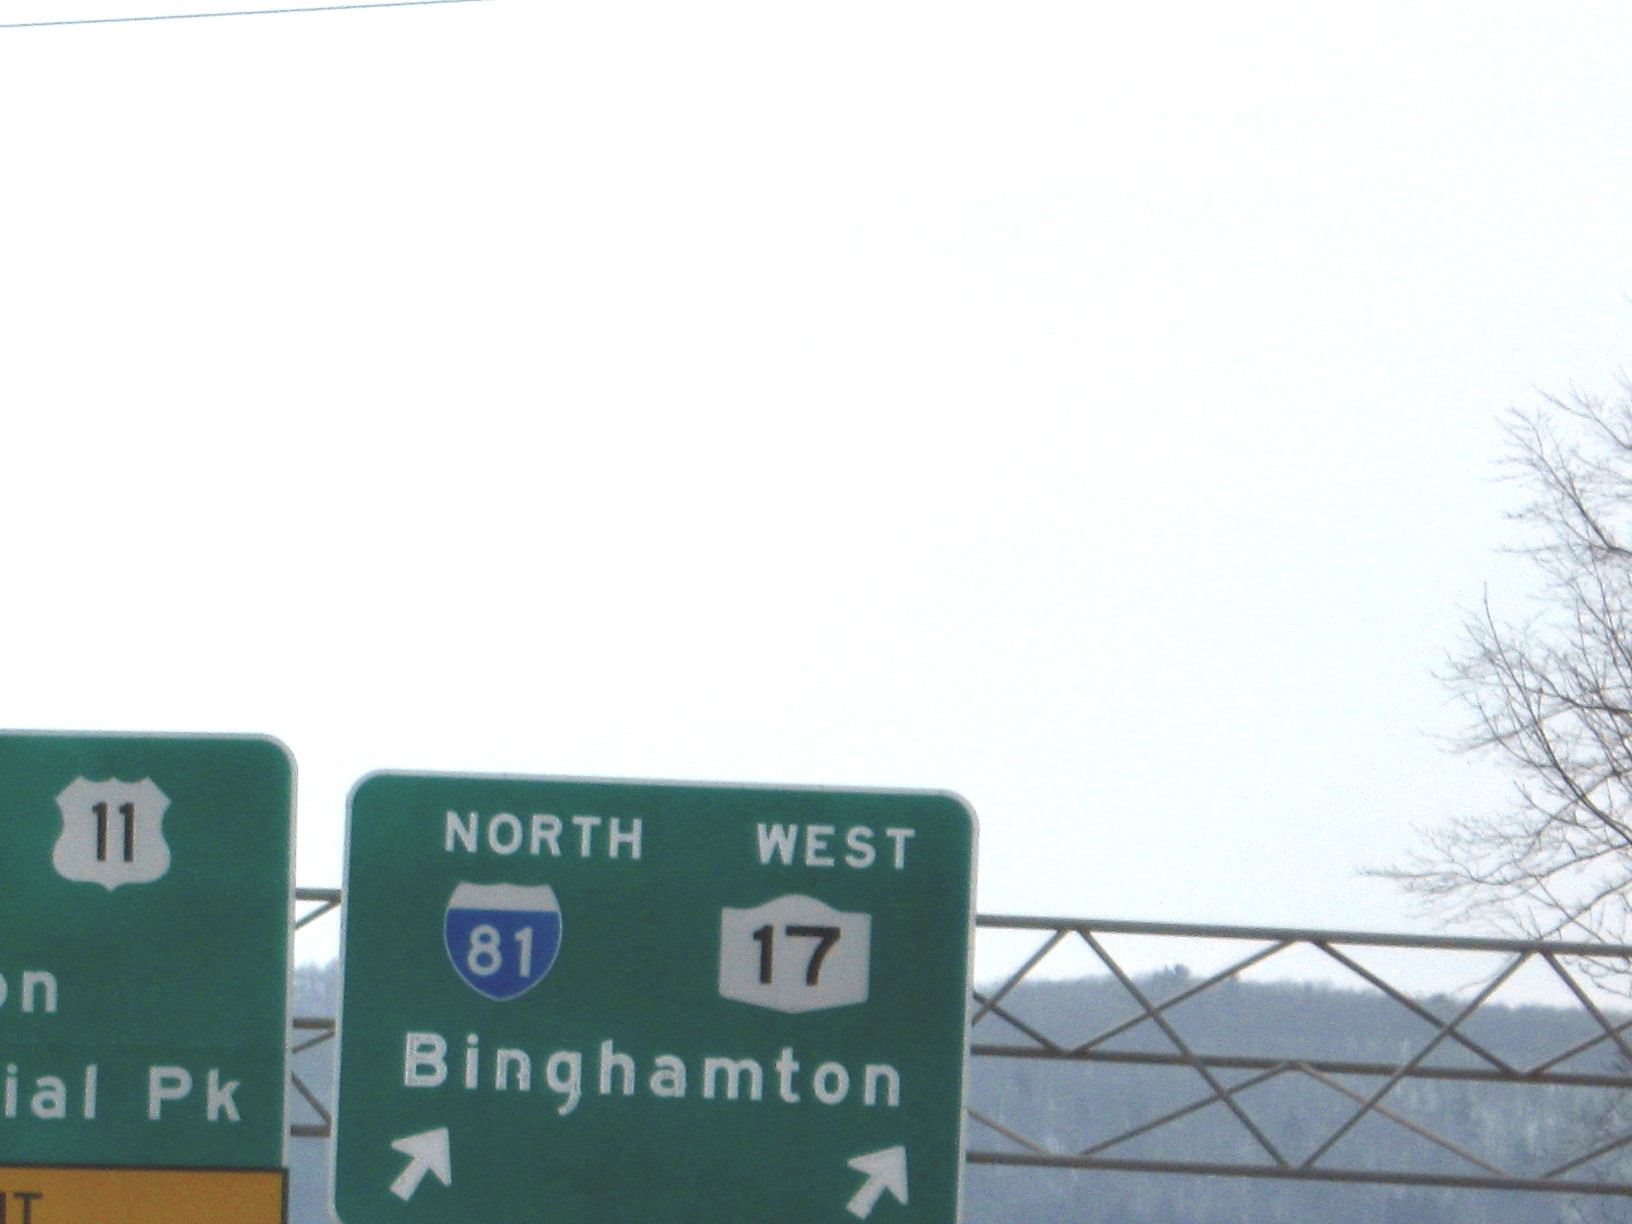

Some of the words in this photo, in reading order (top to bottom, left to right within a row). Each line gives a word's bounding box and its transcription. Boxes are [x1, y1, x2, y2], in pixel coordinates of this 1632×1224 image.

[92, 801, 135, 862] 11
[444, 811, 643, 860] NORTH
[756, 823, 917, 869] WEST
[467, 923, 534, 979] 81
[752, 922, 843, 986] 17
[147, 1065, 242, 1122] Pk
[402, 1032, 901, 1116] Binghamton
